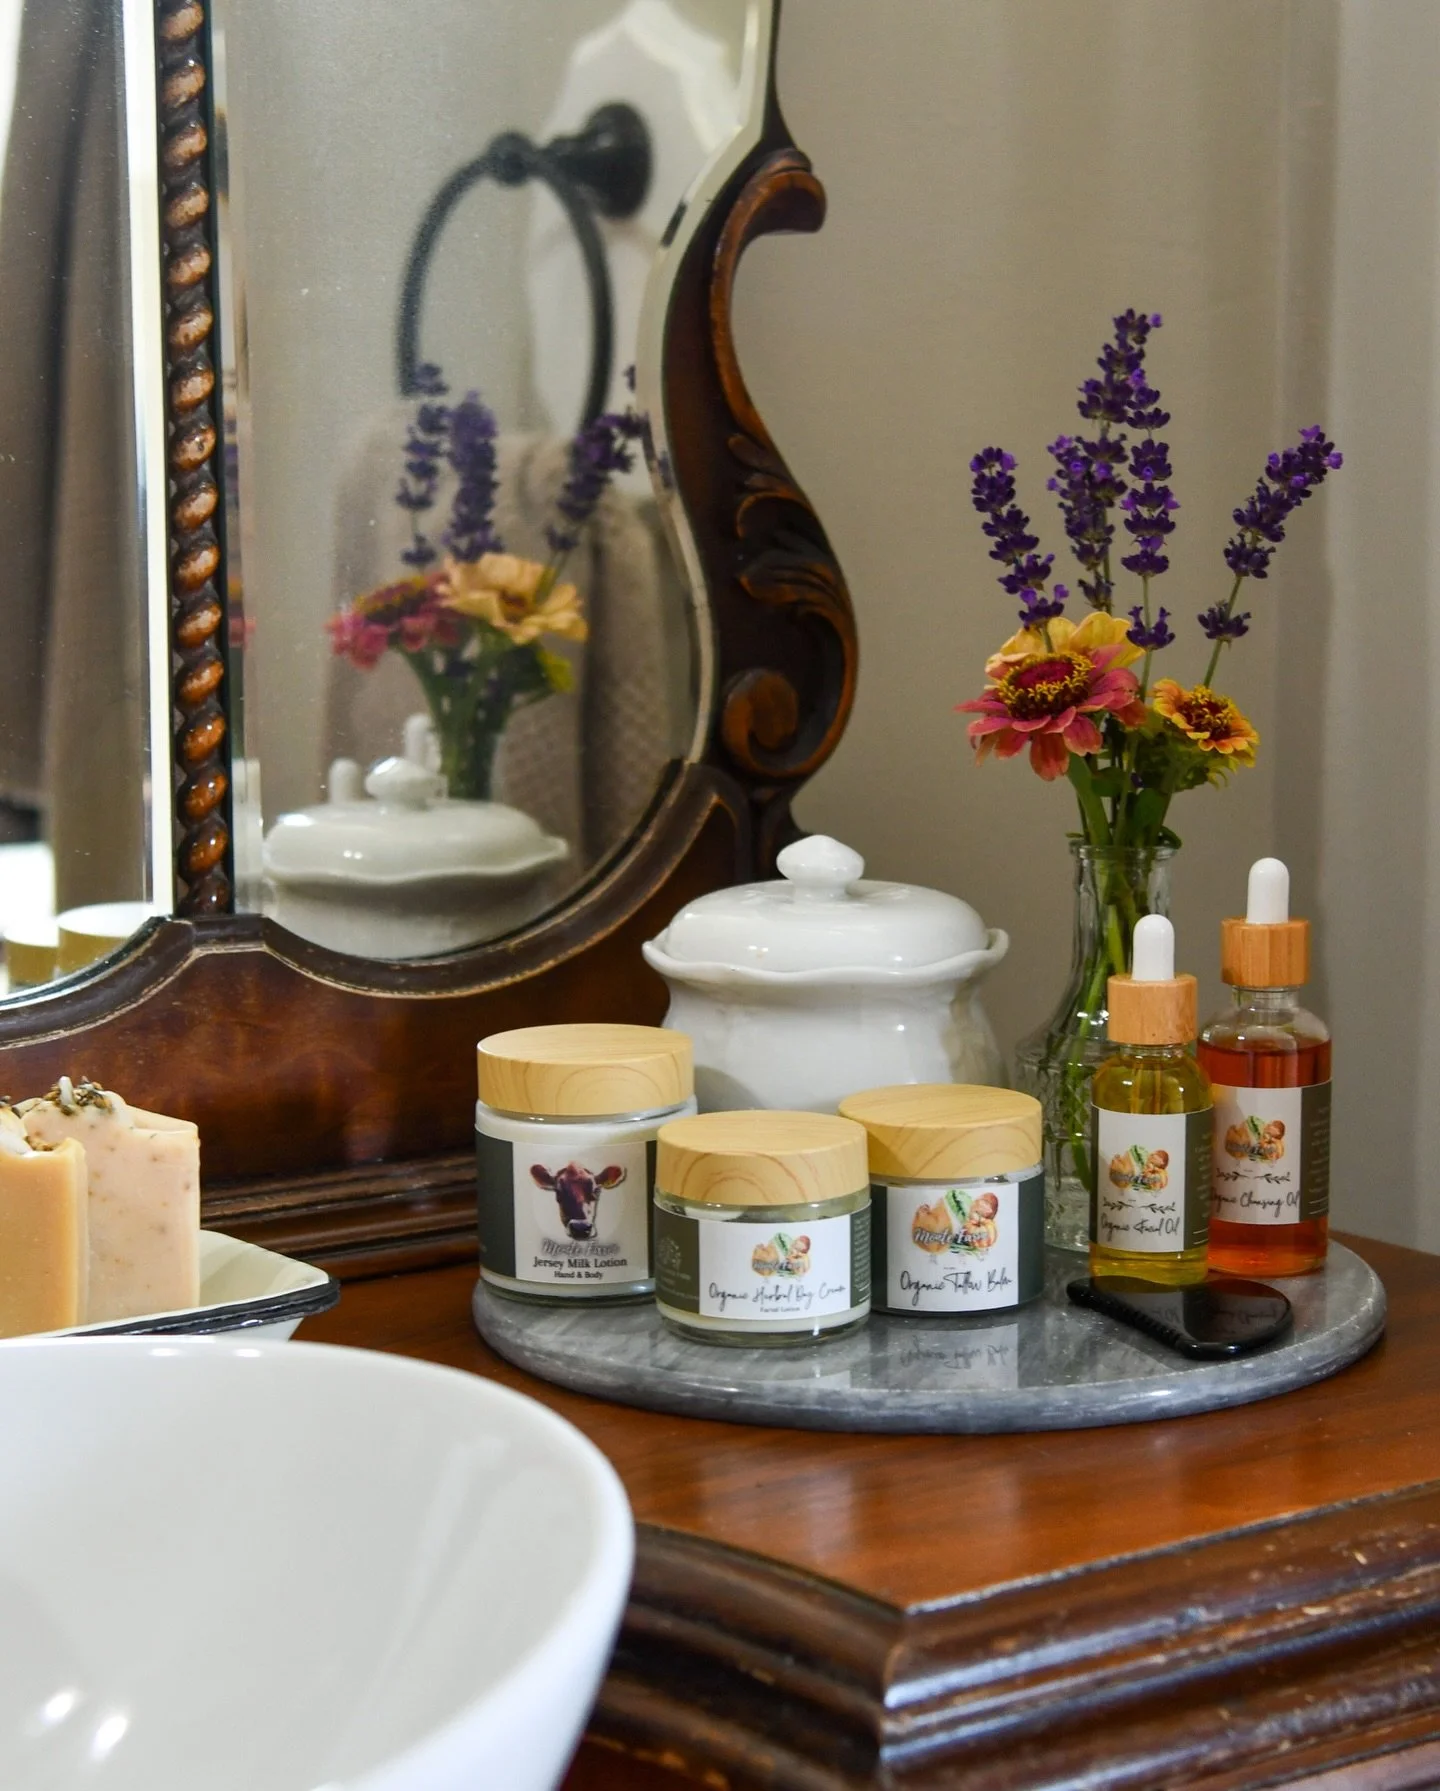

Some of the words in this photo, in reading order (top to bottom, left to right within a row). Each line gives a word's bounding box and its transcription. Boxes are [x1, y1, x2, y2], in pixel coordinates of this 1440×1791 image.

[533, 1256, 564, 1270] Jersey
[568, 1257, 590, 1268] Milk
[594, 1257, 628, 1268] Lotion
[585, 1270, 604, 1280] Body
[708, 1282, 749, 1312] Organic
[752, 1284, 794, 1305] Herbal
[900, 1271, 945, 1306] Organic
[943, 1271, 982, 1294] Tallow
[987, 1267, 1013, 1293] Balm
